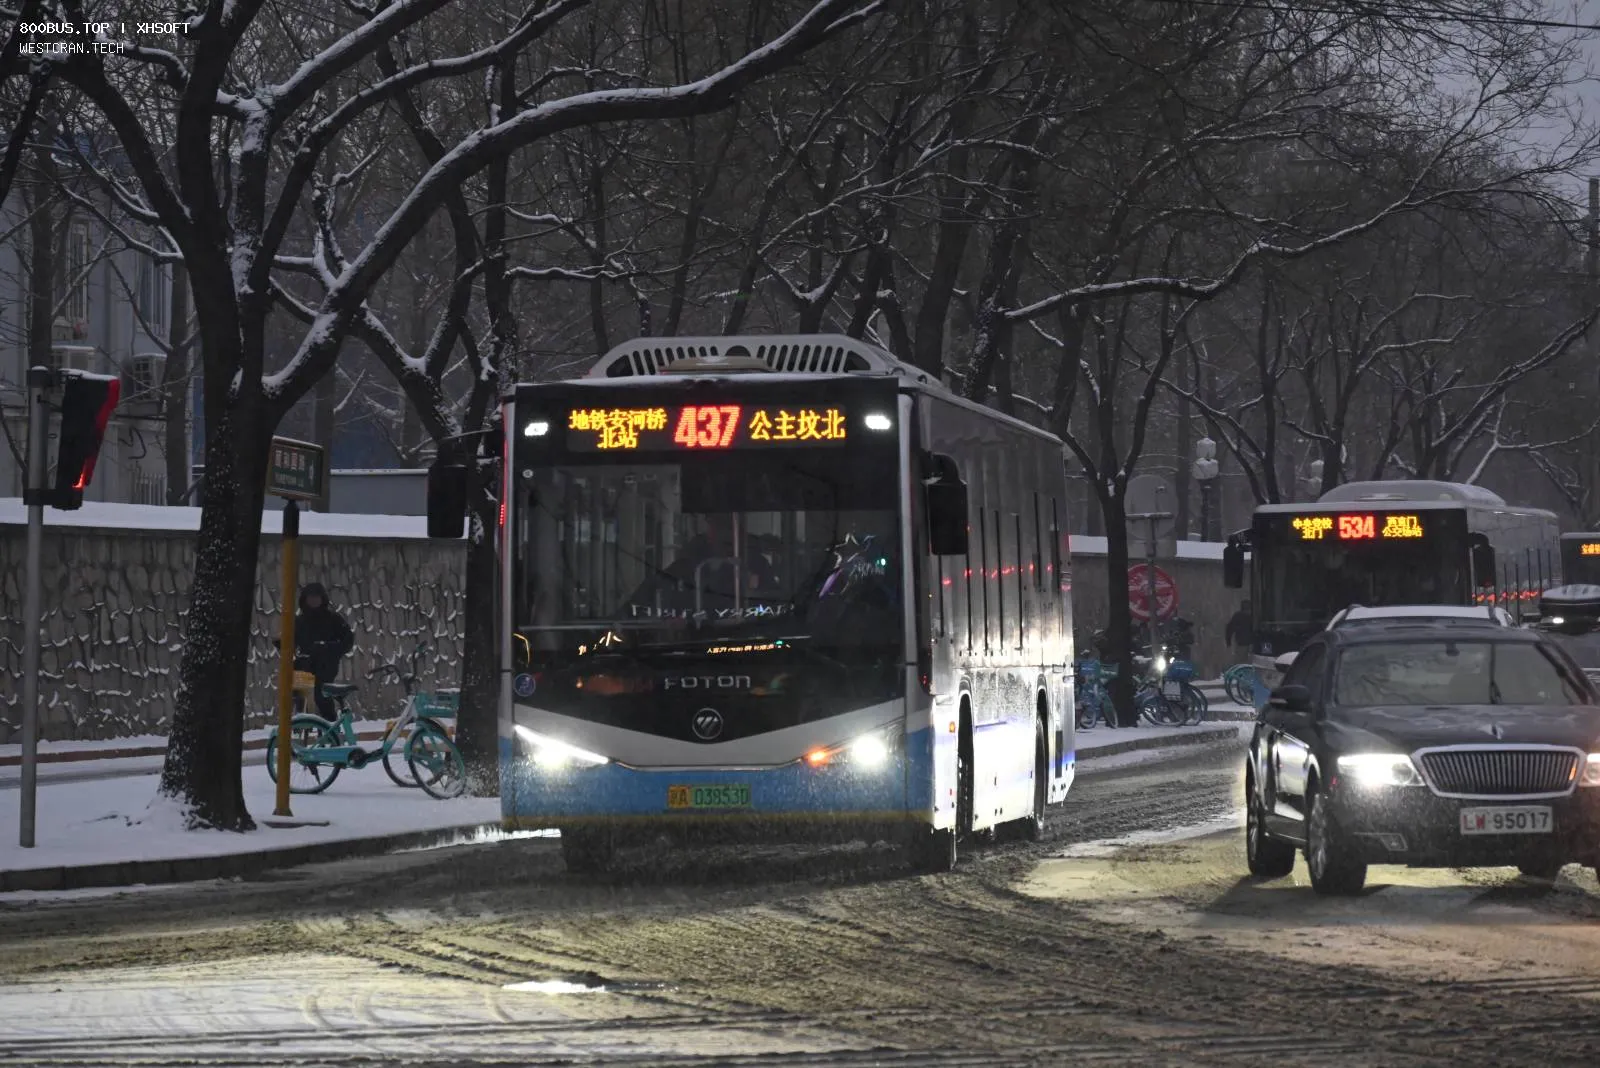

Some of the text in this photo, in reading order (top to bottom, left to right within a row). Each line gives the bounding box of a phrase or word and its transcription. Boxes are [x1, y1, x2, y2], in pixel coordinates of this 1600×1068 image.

[569, 408, 668, 431] 地铁安河桥
[674, 406, 741, 448] 437
[750, 410, 846, 440] 公主坟北
[597, 429, 637, 449] 北站
[1338, 516, 1375, 539] 534
[664, 674, 751, 691] FOTON
[1493, 811, 1549, 830] 95017
